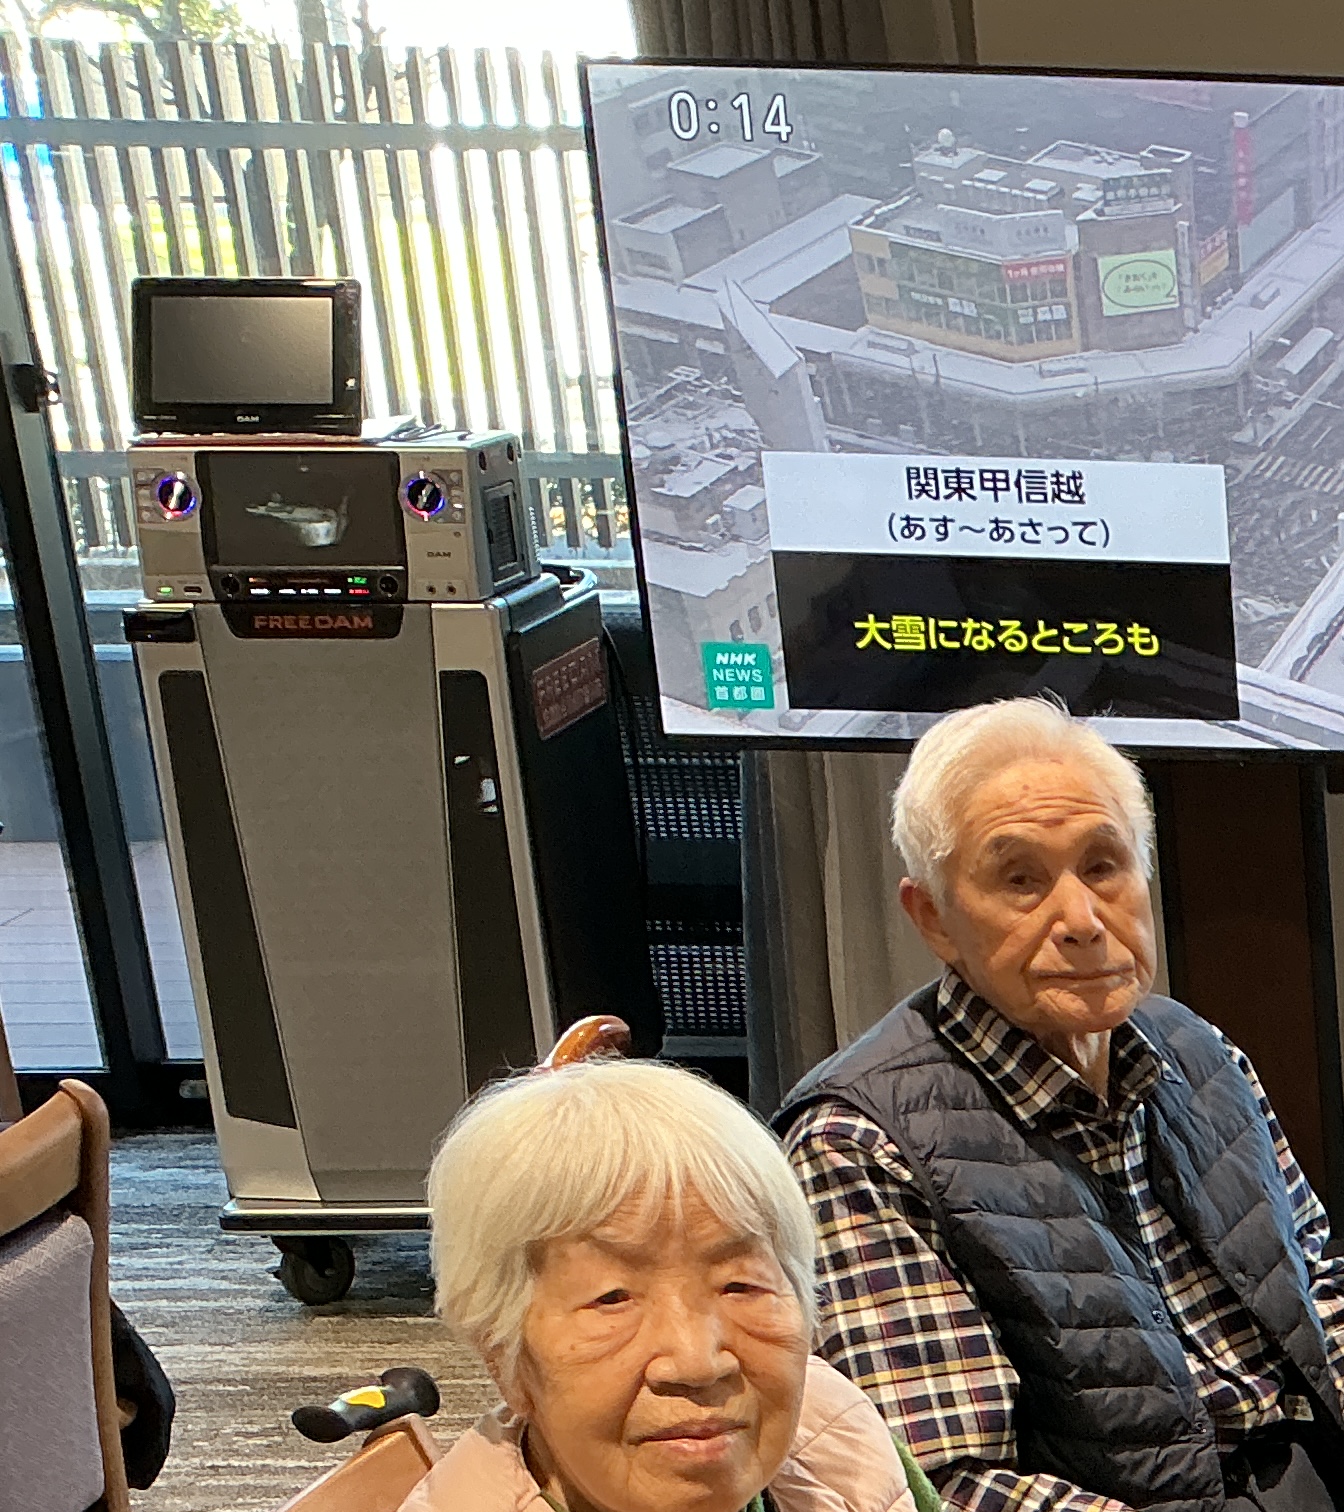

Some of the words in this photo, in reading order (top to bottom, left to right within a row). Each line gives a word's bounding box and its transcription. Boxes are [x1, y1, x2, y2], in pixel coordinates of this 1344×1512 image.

[668, 90, 794, 142] 0:14
[905, 466, 1086, 506] 関東甲信越
[427, 551, 452, 559] DAM
[854, 614, 1160, 657] 大雪になるところも
[715, 652, 757, 666] NHK
[712, 668, 763, 682] NEWS
